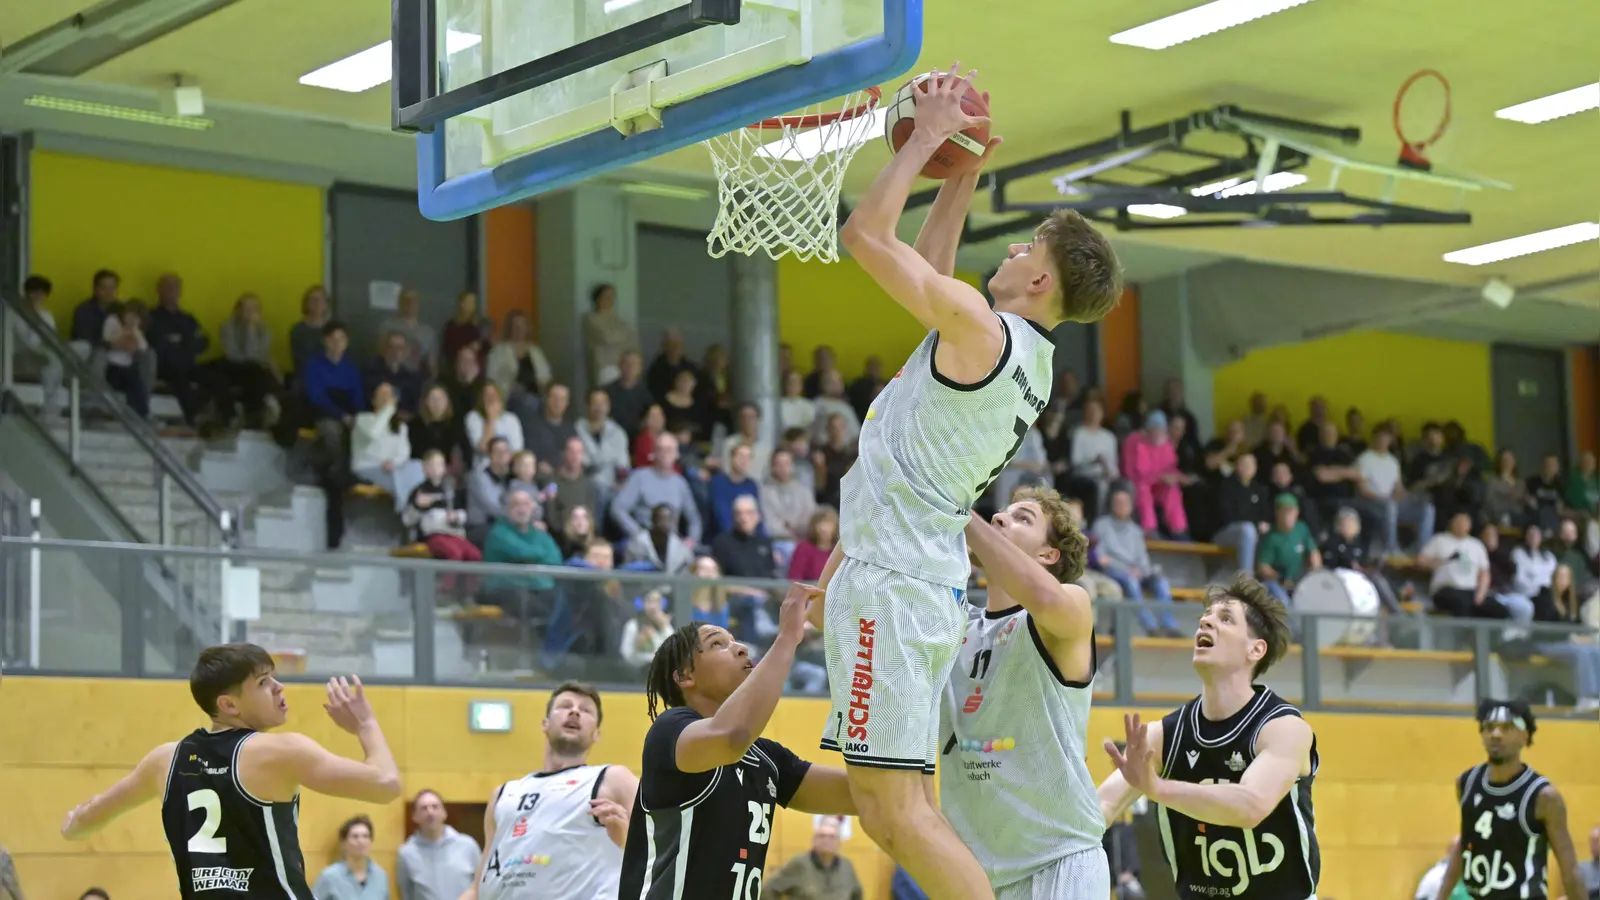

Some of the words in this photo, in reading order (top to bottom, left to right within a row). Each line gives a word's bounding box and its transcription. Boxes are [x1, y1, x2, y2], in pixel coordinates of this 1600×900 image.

[847, 617, 876, 742] SCHÜLLER
[969, 649, 992, 680] 11
[844, 741, 869, 754] JAKO
[517, 792, 541, 812] 13
[187, 788, 227, 854] 2
[748, 800, 771, 845] 25
[1474, 810, 1494, 840] 4
[221, 867, 254, 880] CITY
[1194, 823, 1285, 896] igb
[1462, 842, 1517, 897] igb
[193, 878, 249, 892] WEIMAR
